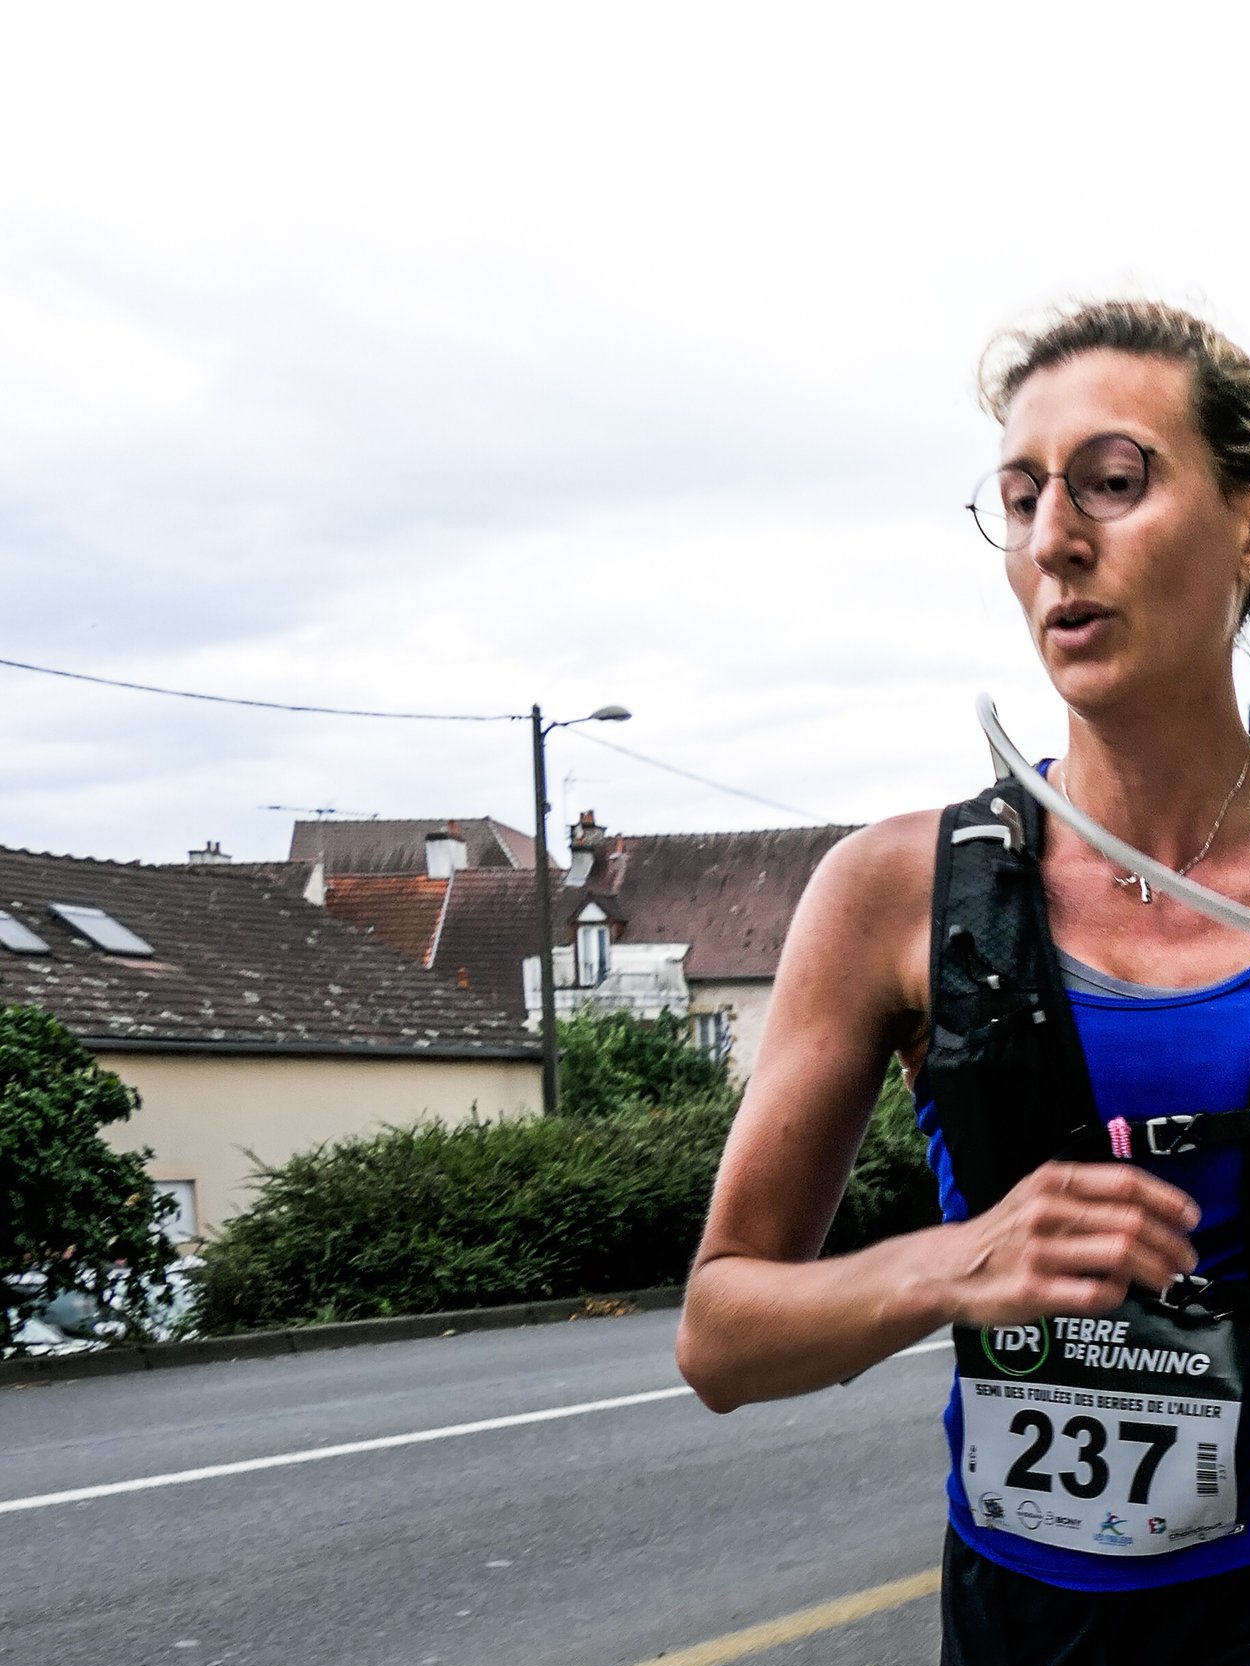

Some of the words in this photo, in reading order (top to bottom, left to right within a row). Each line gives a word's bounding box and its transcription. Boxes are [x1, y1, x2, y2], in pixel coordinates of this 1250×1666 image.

[993, 1324, 1041, 1352] TDR
[1053, 1316, 1130, 1344] TERRE
[976, 1383, 1003, 1397] SEMI
[1004, 1386, 1025, 1399] DES
[1028, 1387, 1072, 1405] FOULÉES
[1075, 1393, 1094, 1407] DES
[1097, 1395, 1143, 1411] BERGES
[1147, 1400, 1164, 1413] DE
[1167, 1402, 1222, 1419] L'ALLIER
[1005, 1408, 1178, 1505] 237
